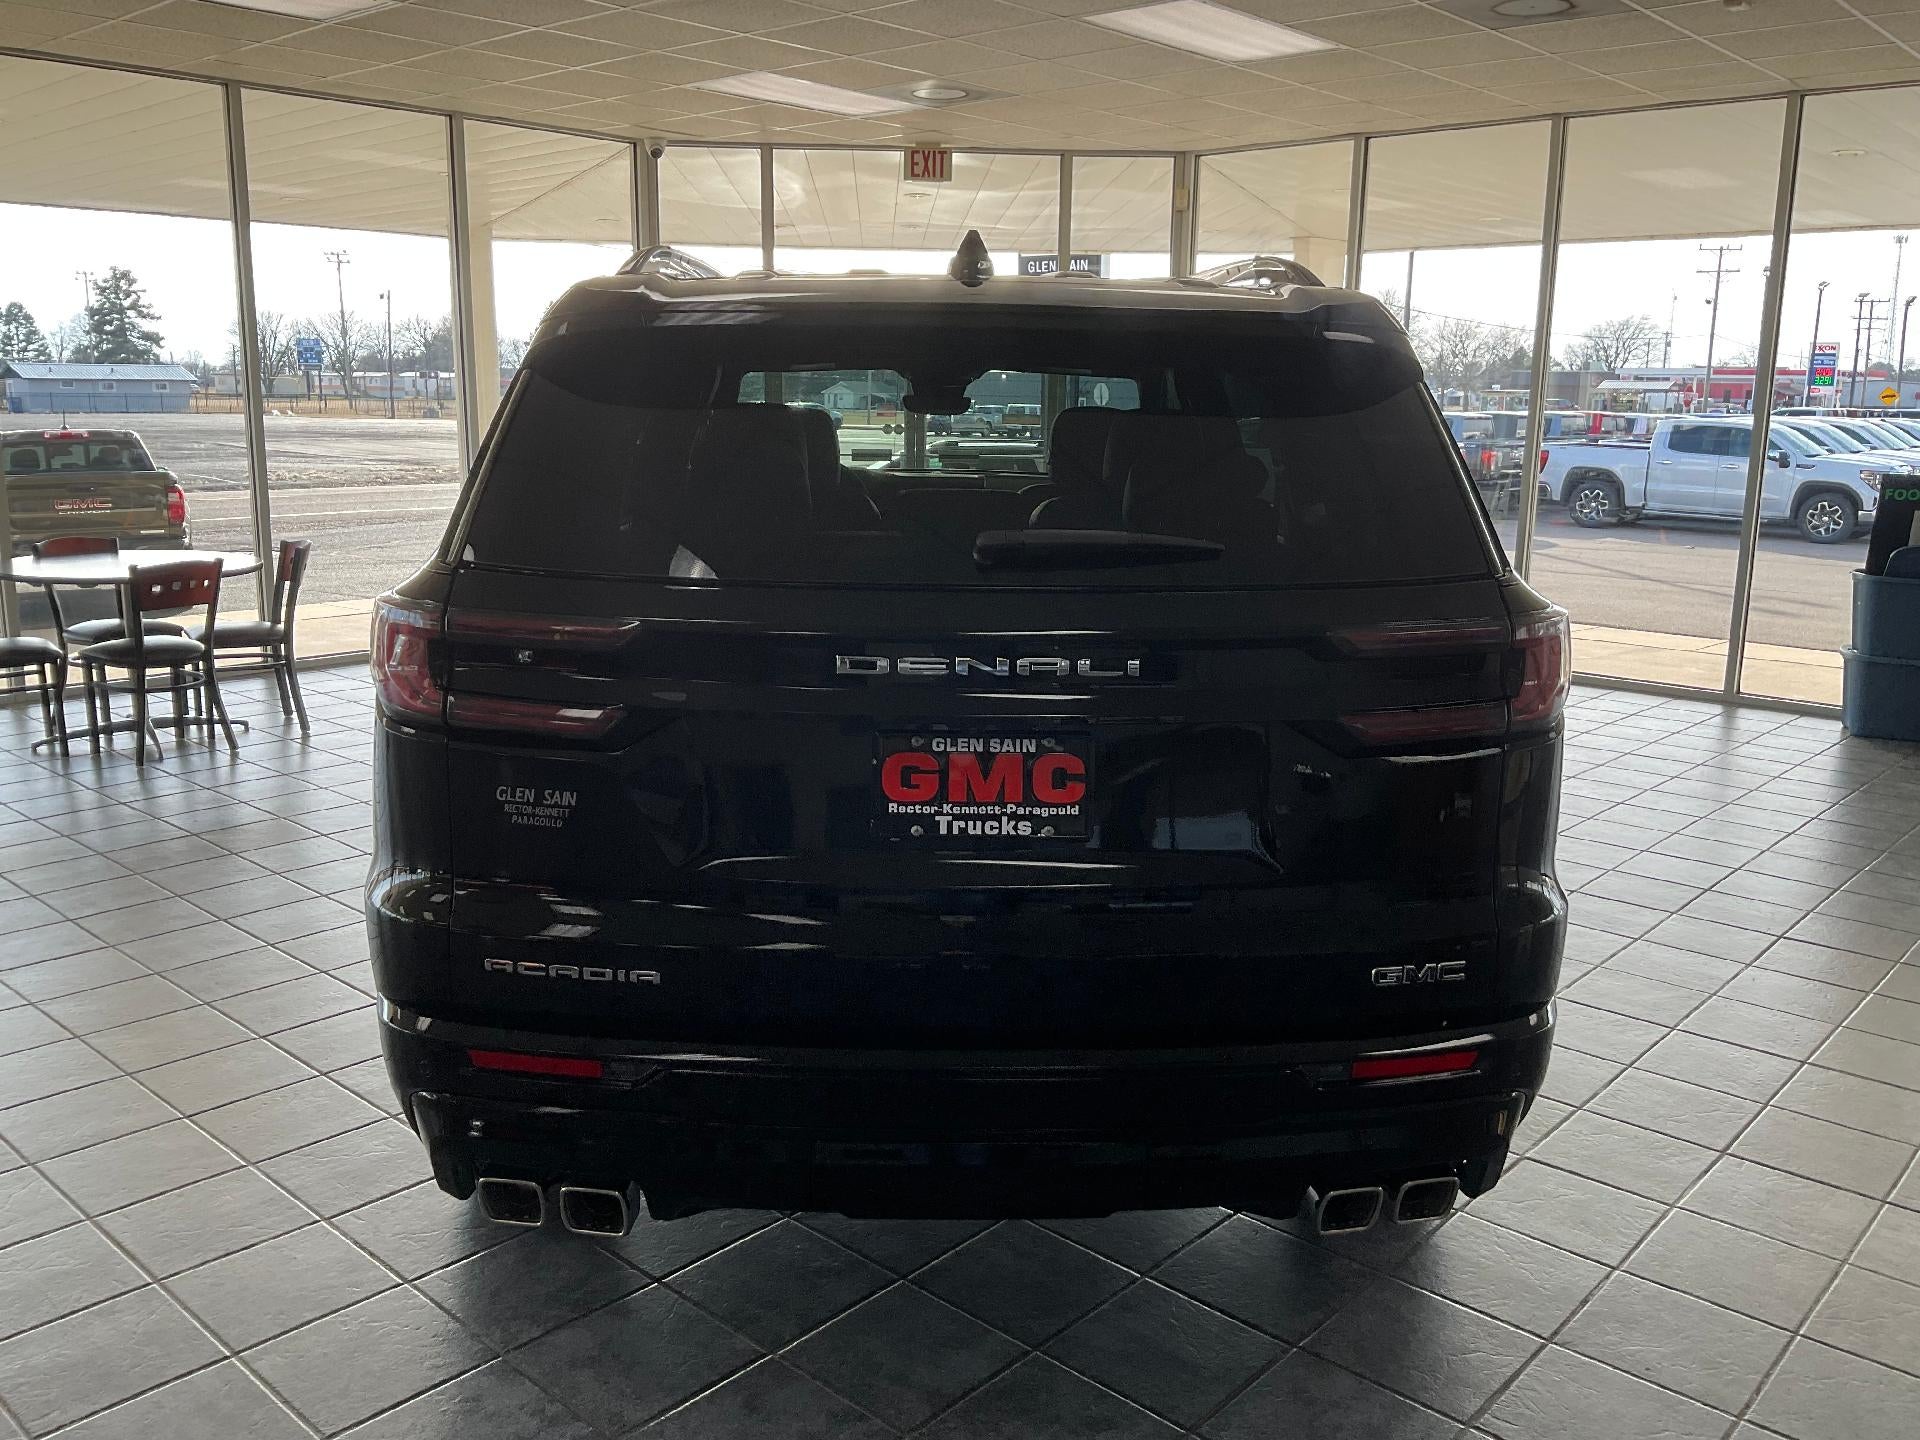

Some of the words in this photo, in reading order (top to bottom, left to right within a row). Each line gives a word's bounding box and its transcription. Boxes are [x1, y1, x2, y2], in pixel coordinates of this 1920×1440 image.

[910, 149, 948, 178] EXIT
[1027, 259, 1057, 273] GLEN
[1069, 258, 1089, 271] AIN
[54, 497, 112, 510] GMC
[836, 655, 1140, 677] DENALI
[931, 737, 984, 752] GLEN
[989, 738, 1036, 753] SAIN
[881, 751, 1086, 805] GMC
[496, 786, 535, 802] GLEN
[542, 789, 577, 806] SAIN
[511, 815, 563, 828] PARAGOULD
[934, 815, 1032, 836] Trucks
[484, 958, 661, 985] ACADIA
[1371, 960, 1466, 987] GMC
